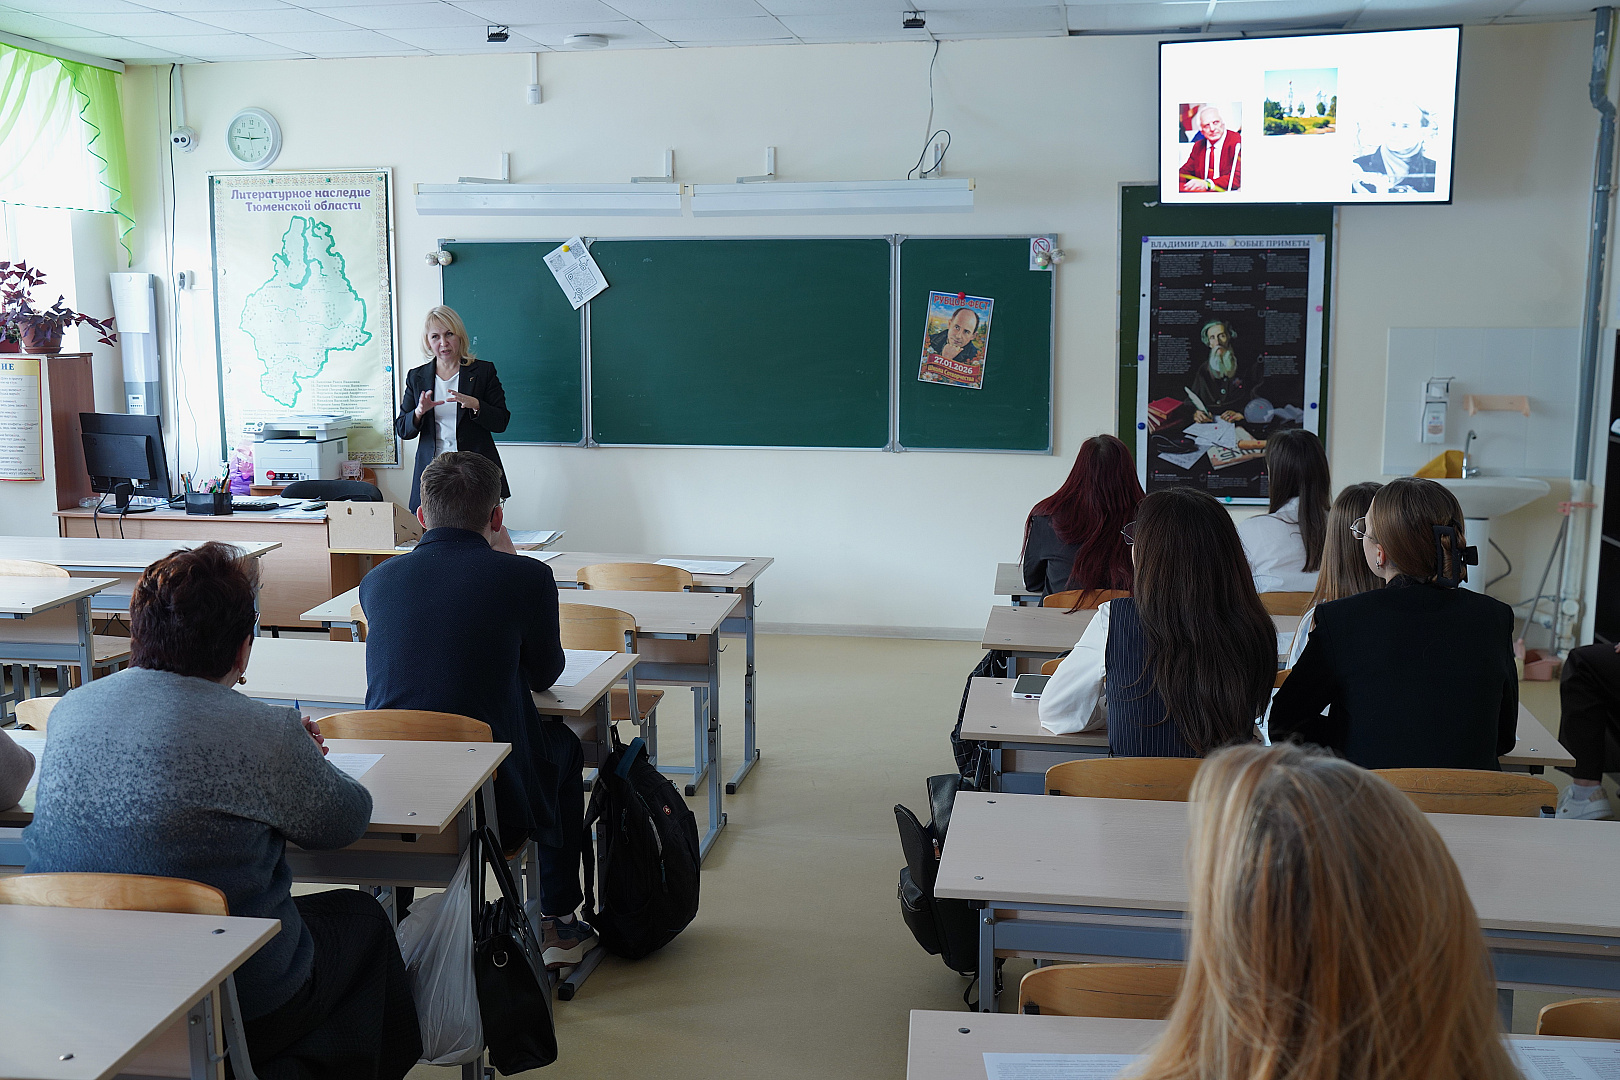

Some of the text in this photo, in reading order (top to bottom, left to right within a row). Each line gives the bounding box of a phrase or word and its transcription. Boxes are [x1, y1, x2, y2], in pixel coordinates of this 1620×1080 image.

[230, 189, 371, 201] Литературное наследие
[245, 200, 362, 212] Тюменской области
[1150, 240, 1200, 248] ВЛАДИМИР
[1200, 240, 1226, 248] ДАЛЬ.
[1266, 239, 1310, 247] ПРИМЕТЫ
[933, 295, 990, 310] РУБЦОВ-ФЕСТ
[934, 356, 973, 375] 27.01.2026
